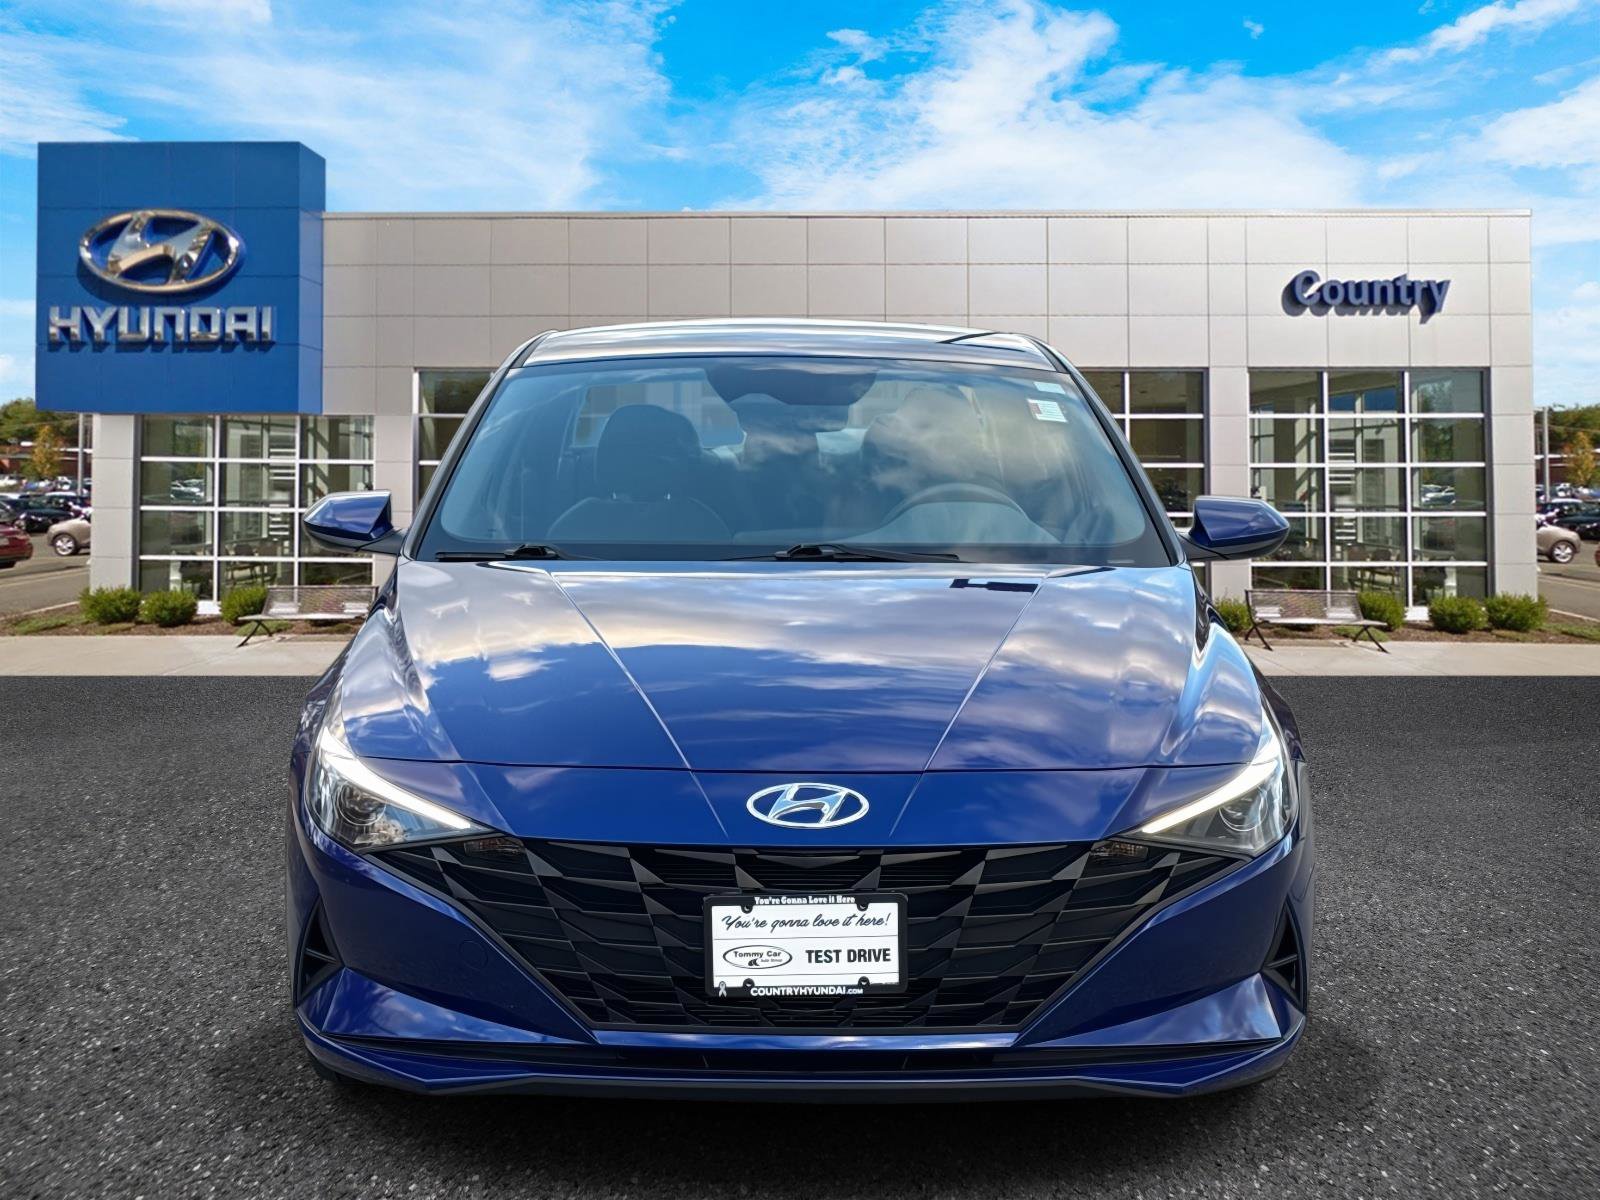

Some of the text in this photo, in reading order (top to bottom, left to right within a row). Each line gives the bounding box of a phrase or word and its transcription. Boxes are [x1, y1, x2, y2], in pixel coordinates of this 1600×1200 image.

[1283, 270, 1451, 323] Country
[49, 305, 272, 344] HYUNDAI
[754, 896, 780, 905] You're
[781, 896, 807, 904] Gonna
[808, 895, 828, 904] Love
[836, 895, 856, 904] Here
[721, 913, 891, 933] You're gonna love it here!
[733, 950, 764, 959] Tommy
[805, 948, 891, 964] TEST DRIVE
